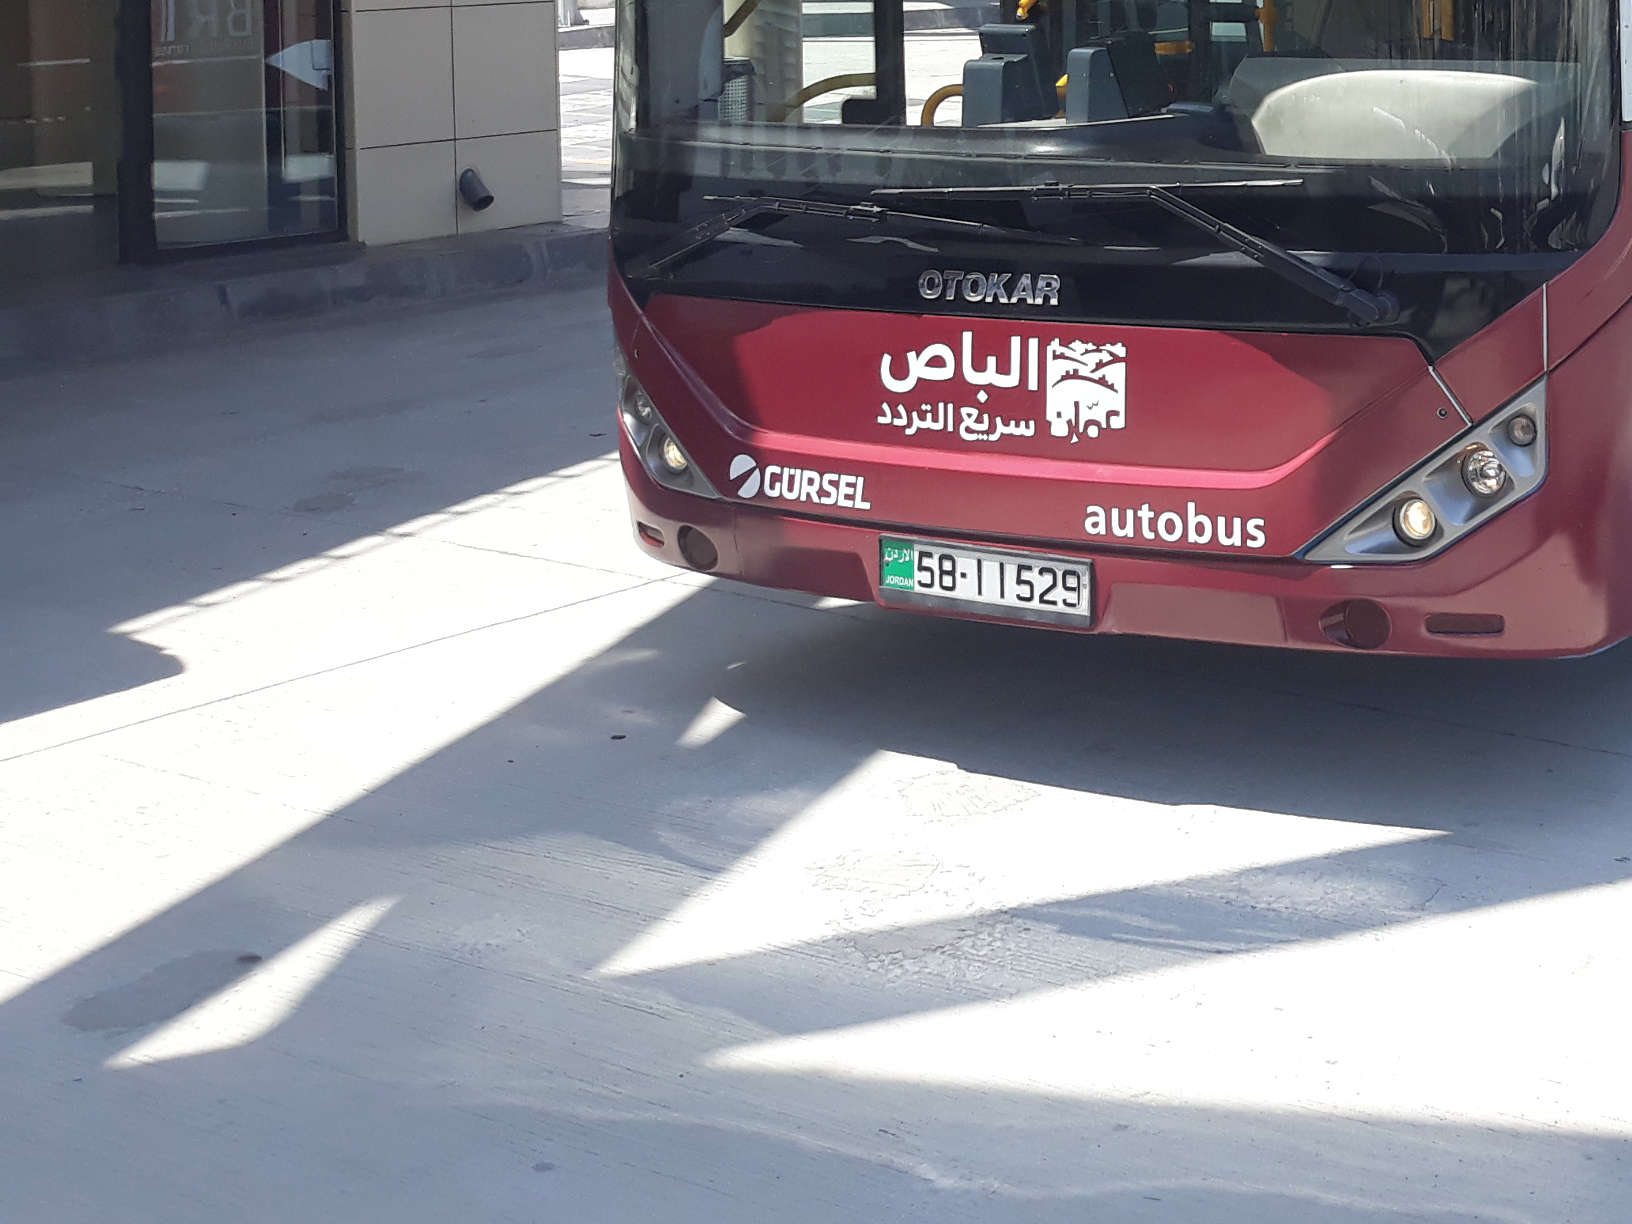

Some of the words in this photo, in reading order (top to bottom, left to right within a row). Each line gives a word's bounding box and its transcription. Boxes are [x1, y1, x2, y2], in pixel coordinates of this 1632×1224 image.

[918, 269, 1061, 306] OTOKAR
[879, 330, 1040, 404] الباص
[876, 401, 955, 436] التردد
[958, 406, 1037, 442] سريع
[763, 465, 871, 511] GÜRSEL
[1084, 502, 1267, 549] autobus
[885, 574, 914, 587] JORDAN
